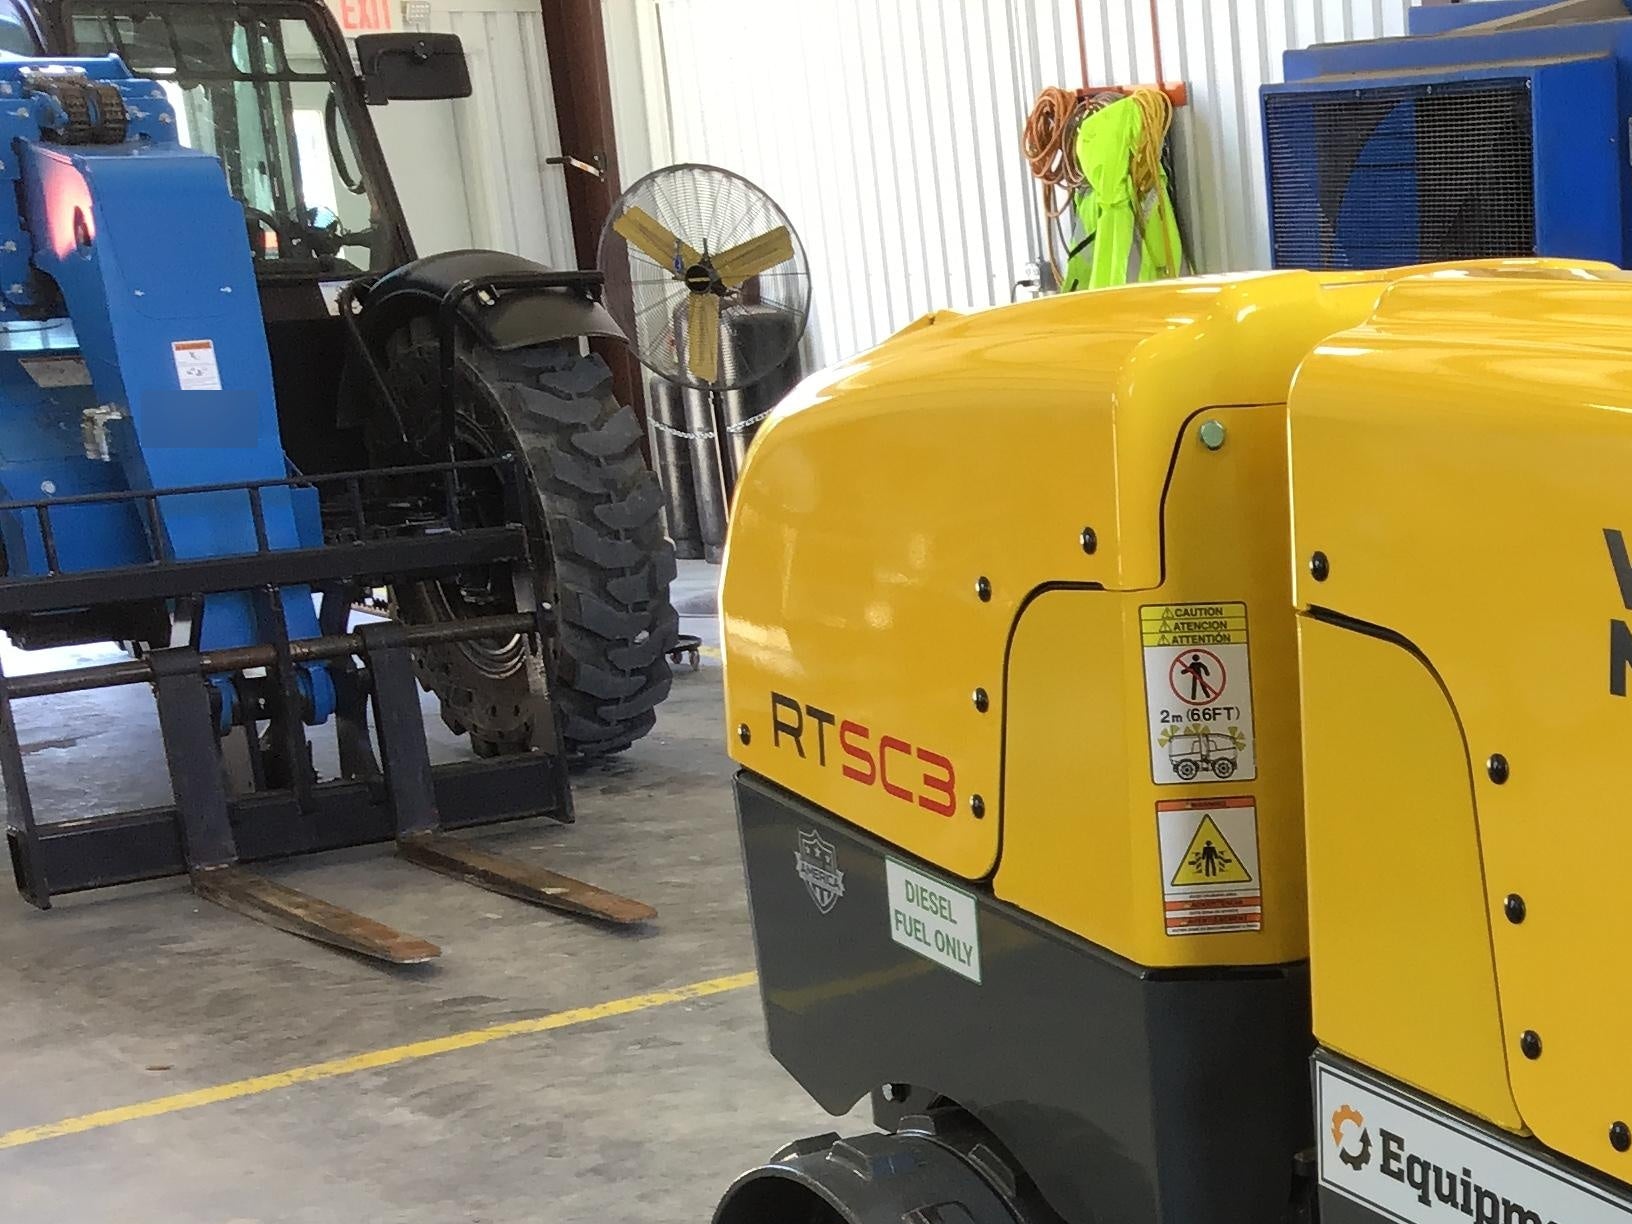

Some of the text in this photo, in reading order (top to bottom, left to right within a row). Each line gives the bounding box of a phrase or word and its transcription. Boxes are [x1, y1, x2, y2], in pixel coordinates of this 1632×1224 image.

[1174, 606, 1224, 618] CAUTION
[1160, 709, 1183, 723] 2m
[771, 691, 956, 817] RTSC3
[904, 879, 957, 925] DIESEL
[894, 909, 974, 967] FUEL ONLY
